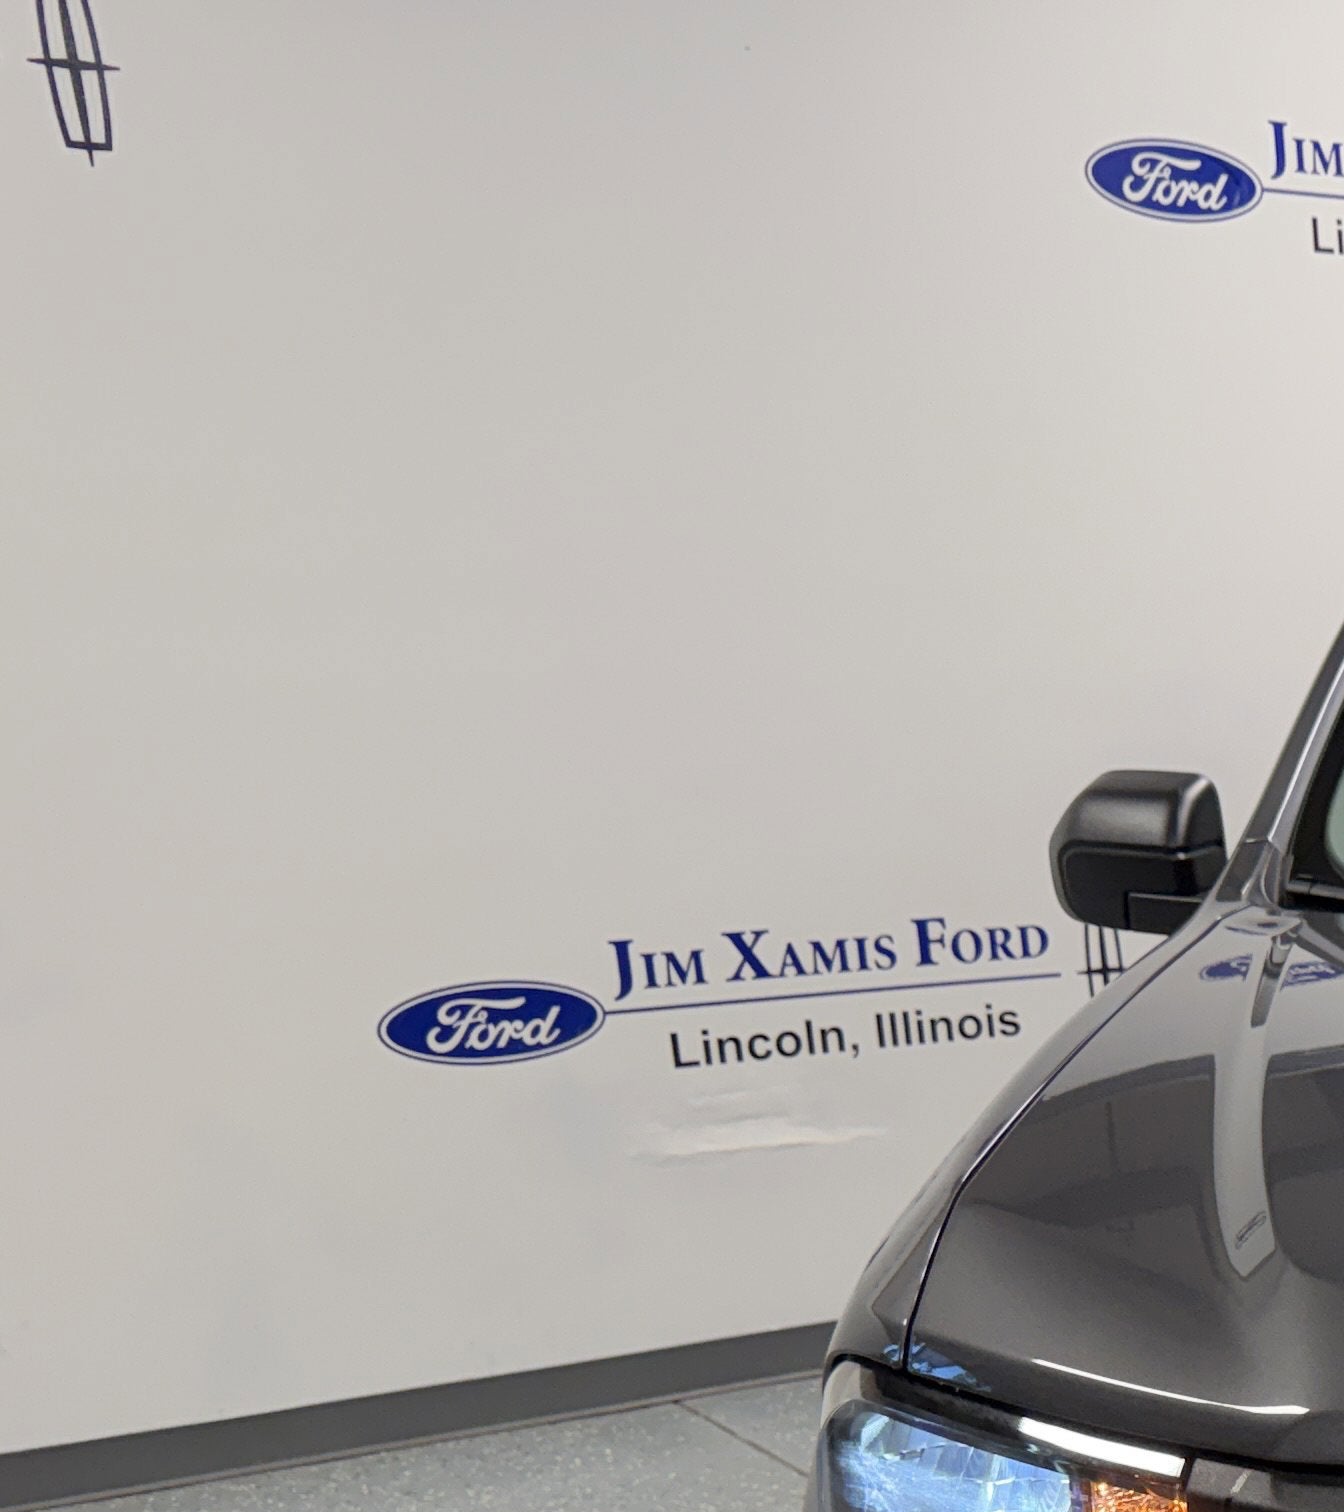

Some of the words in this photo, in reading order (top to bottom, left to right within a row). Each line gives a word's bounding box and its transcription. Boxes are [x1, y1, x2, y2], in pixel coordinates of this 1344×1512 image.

[1268, 119, 1344, 181] JIM
[607, 938, 709, 1003] JIM
[720, 928, 898, 984] XAMIS
[910, 917, 1050, 968] FORD
[669, 1018, 861, 1070] Lincoln,
[875, 1003, 1022, 1050] Illinois
